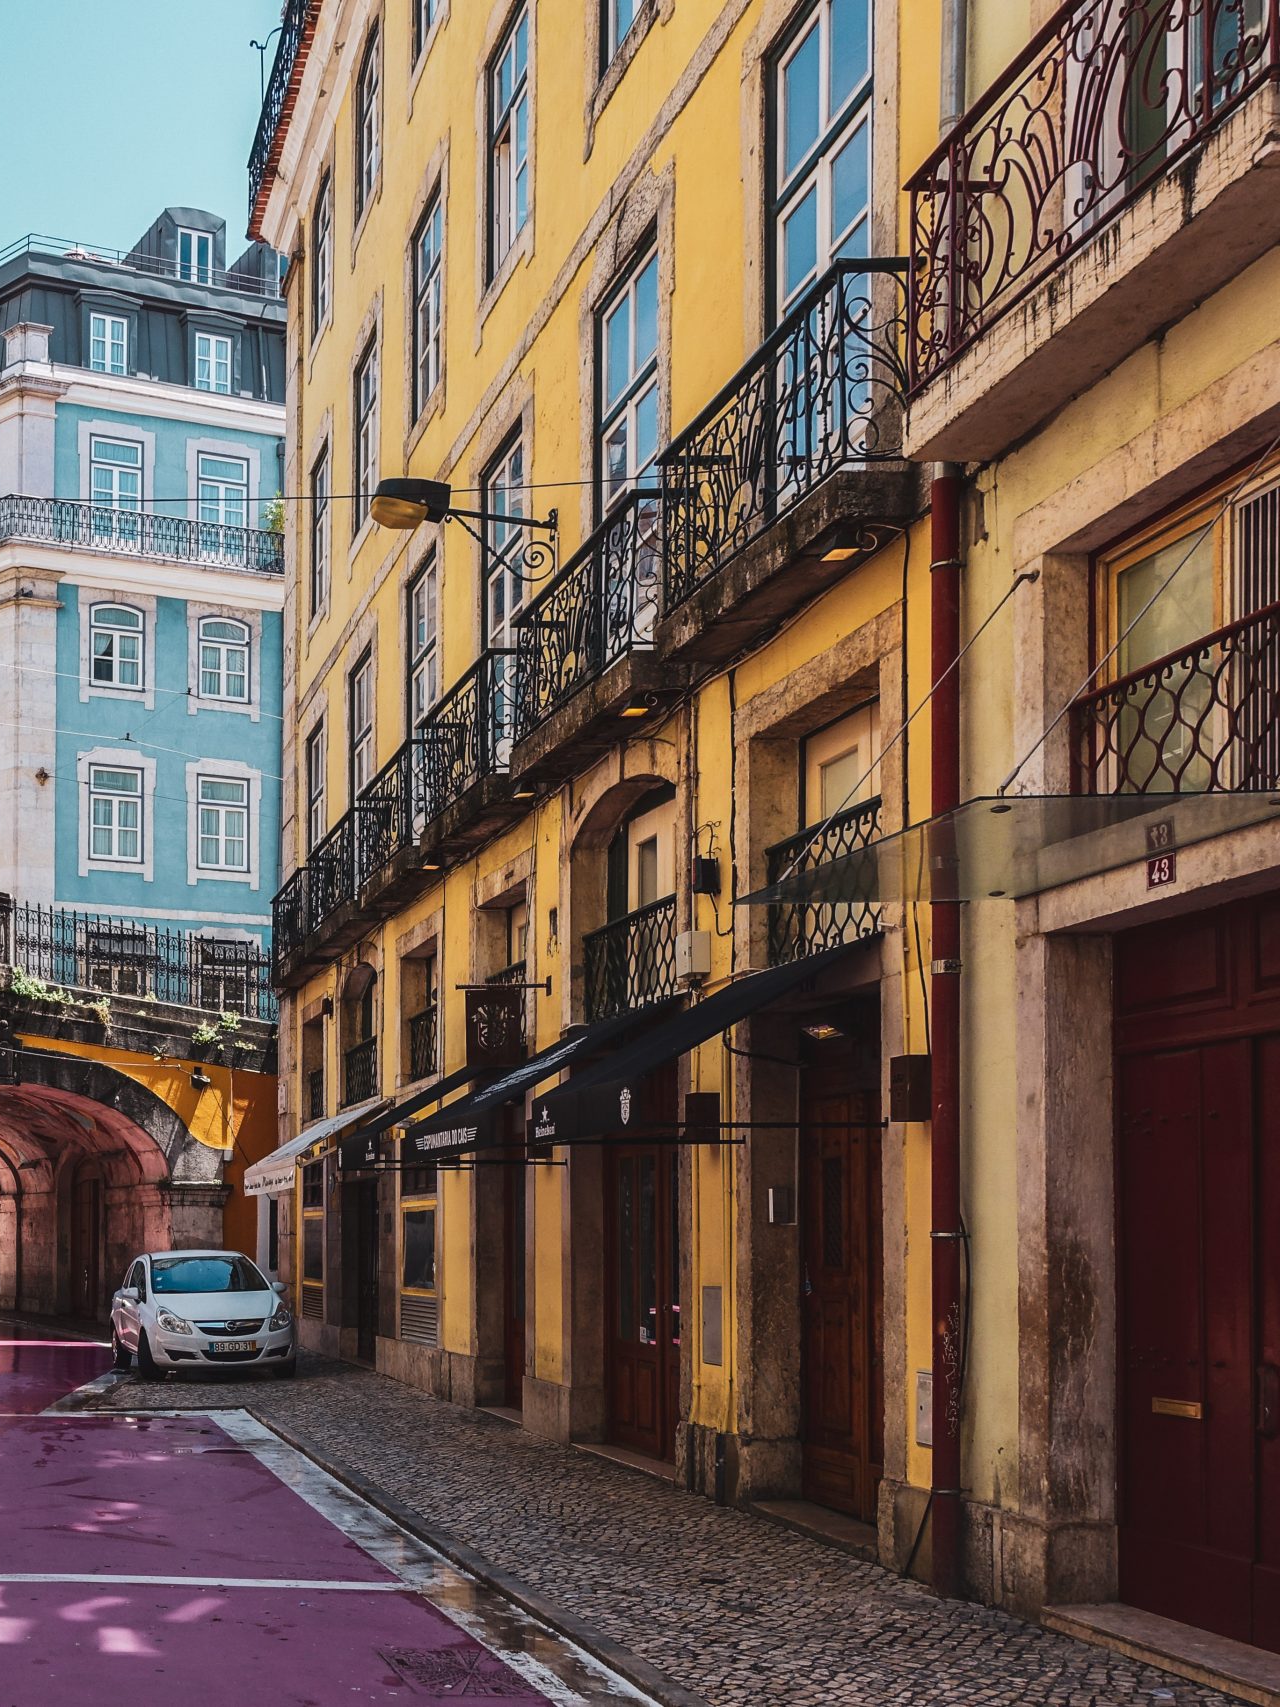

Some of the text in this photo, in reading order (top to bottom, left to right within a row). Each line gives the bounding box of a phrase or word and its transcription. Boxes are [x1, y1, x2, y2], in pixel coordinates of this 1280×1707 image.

[1152, 859, 1169, 883] 43
[452, 1129, 458, 1146] DO
[535, 1123, 556, 1138] Heineken
